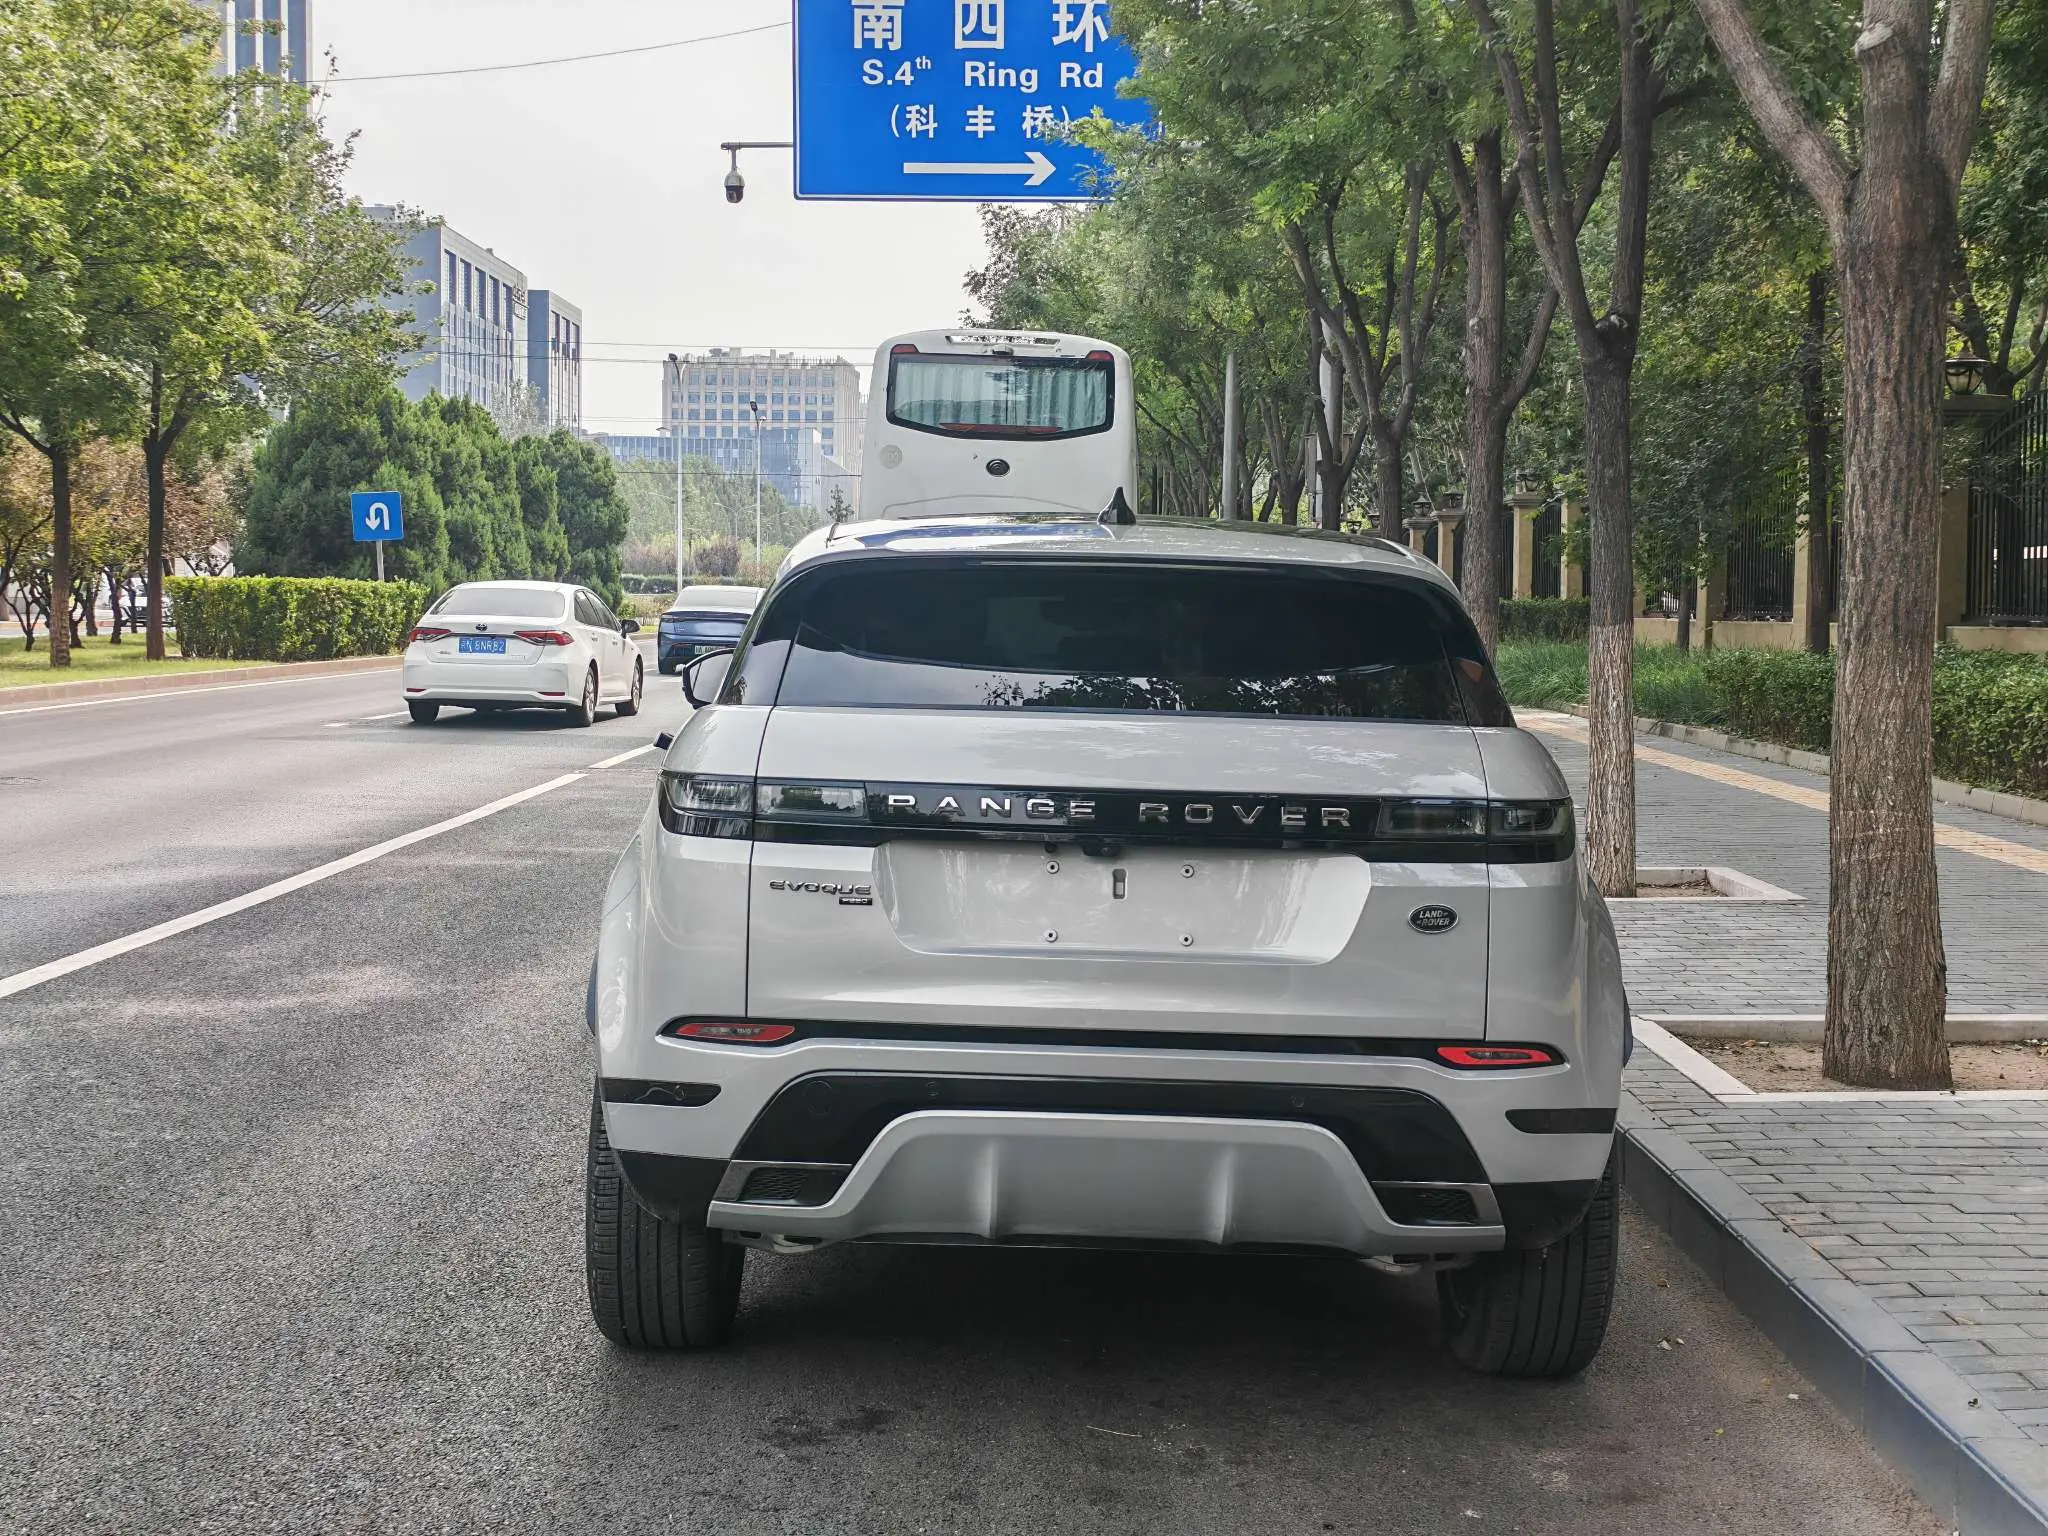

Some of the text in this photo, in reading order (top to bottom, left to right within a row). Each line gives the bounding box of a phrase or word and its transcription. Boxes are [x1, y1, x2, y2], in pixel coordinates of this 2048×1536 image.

[853, 0, 1109, 52] 南四环
[862, 56, 1103, 93] S.4th Ring Rd
[887, 794, 1351, 827] RANGE ROVER
[769, 879, 872, 895] EVOQUE
